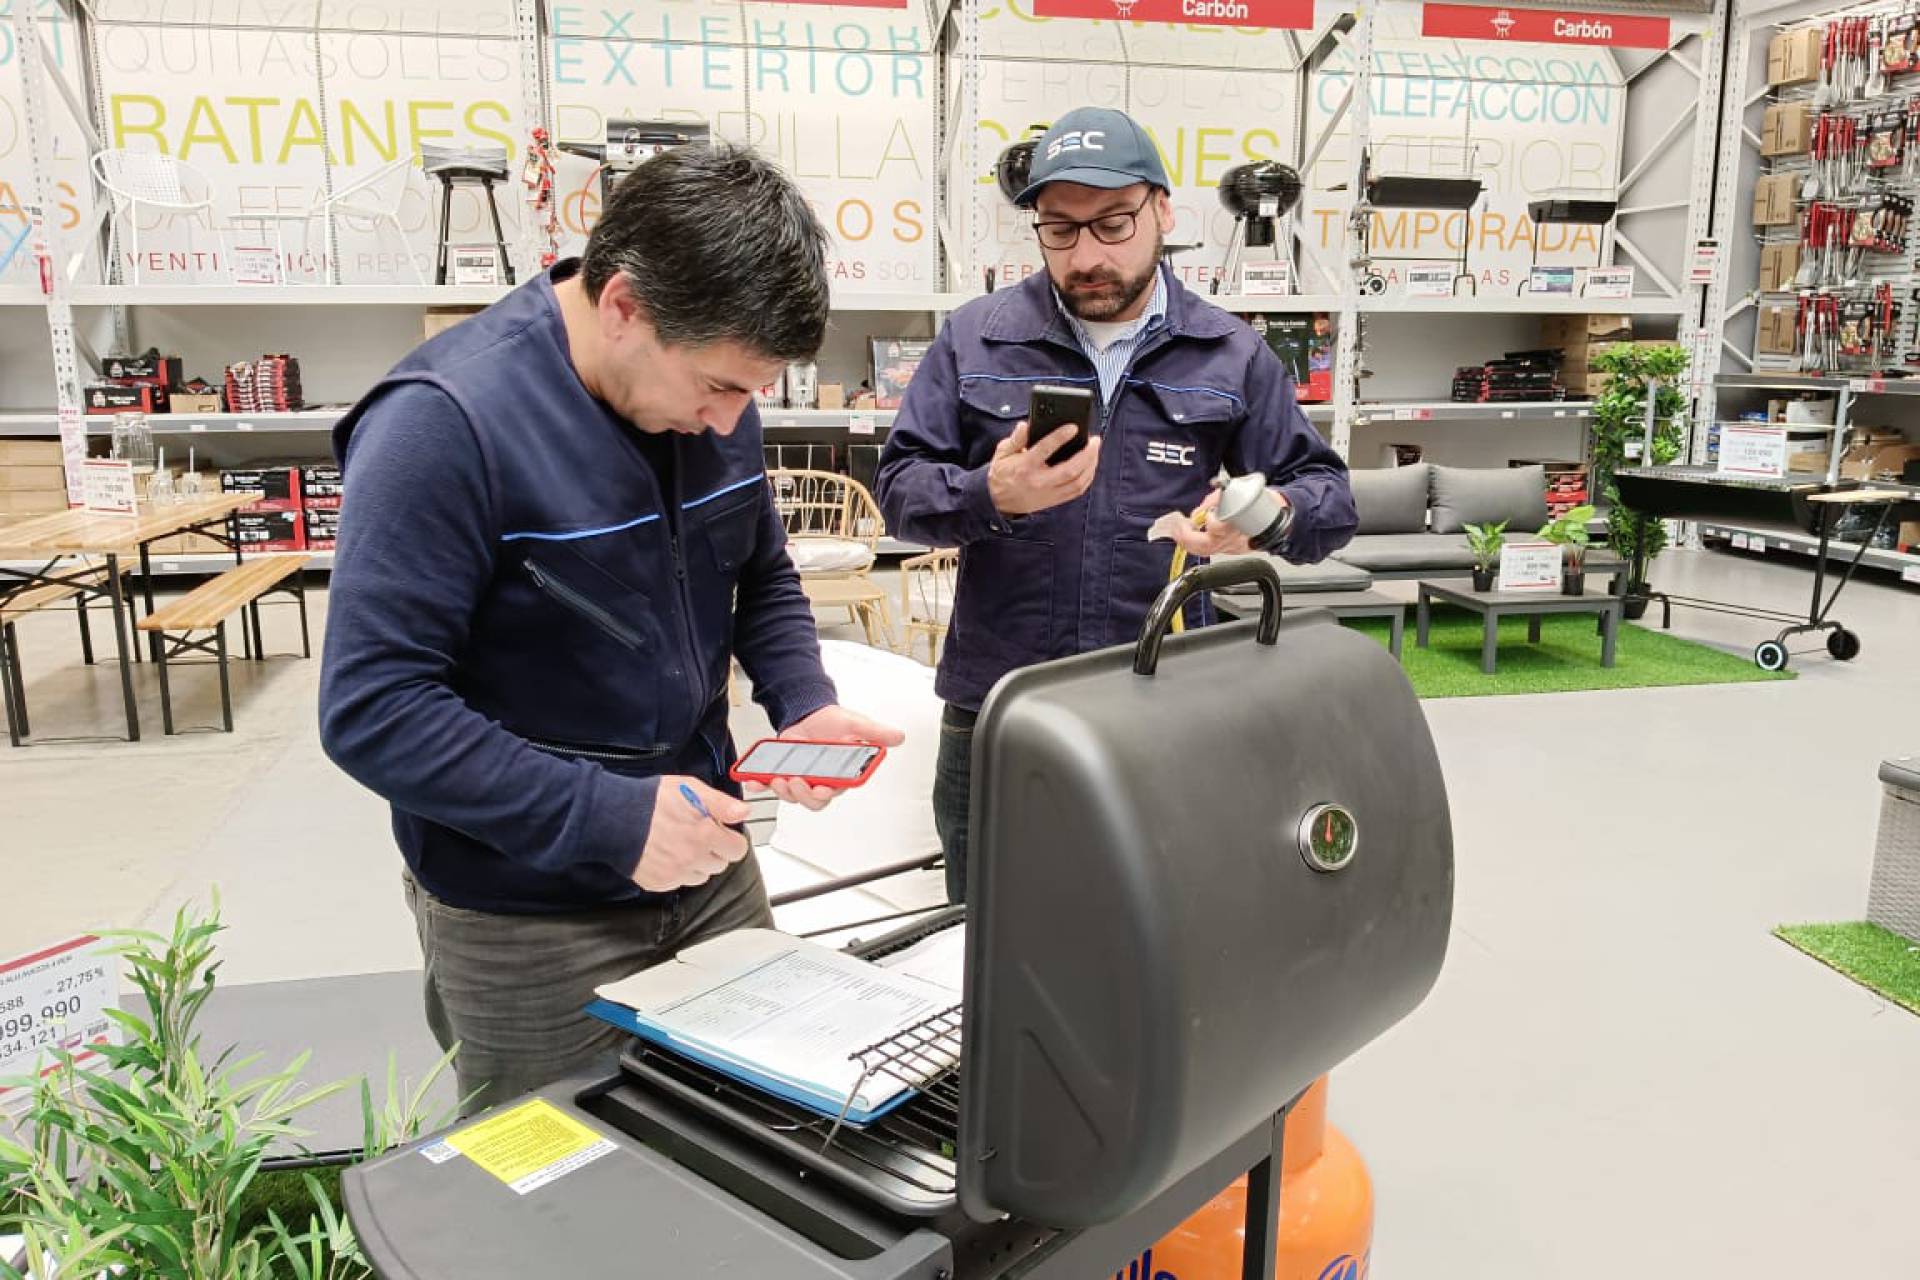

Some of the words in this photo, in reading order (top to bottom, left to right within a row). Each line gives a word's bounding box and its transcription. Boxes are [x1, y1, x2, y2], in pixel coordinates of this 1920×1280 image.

[1182, 0, 1249, 19] Carbón
[1553, 18, 1613, 40] Carbón
[553, 36, 924, 98] EXTERIOR
[1316, 74, 1613, 125] CLEFACCION
[109, 93, 516, 168] RATANES
[555, 103, 923, 181] PRILLA
[1046, 130, 1106, 161] SEC
[1311, 209, 1598, 253] TMPORADA
[1145, 441, 1196, 467] SEC
